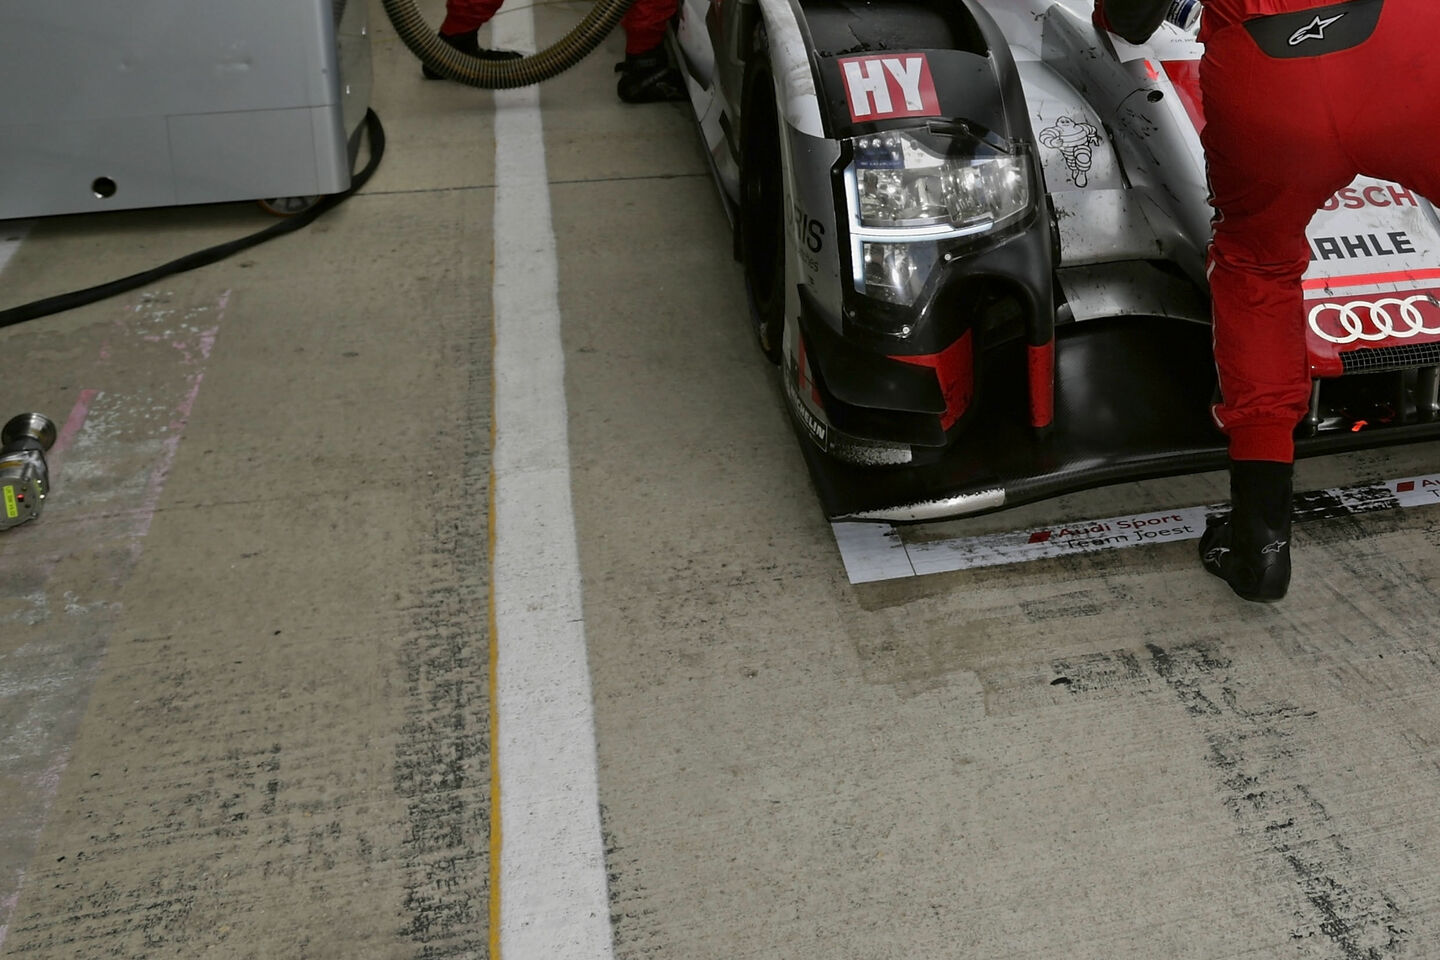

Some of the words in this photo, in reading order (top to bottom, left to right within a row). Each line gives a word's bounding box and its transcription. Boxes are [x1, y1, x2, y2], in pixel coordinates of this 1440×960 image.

[842, 57, 924, 117] HY
[1309, 231, 1416, 262] AHLE
[1058, 522, 1112, 538] Audi
[1116, 514, 1183, 530] Sport
[1066, 534, 1129, 549] Team
[1134, 524, 1195, 541] Joest
